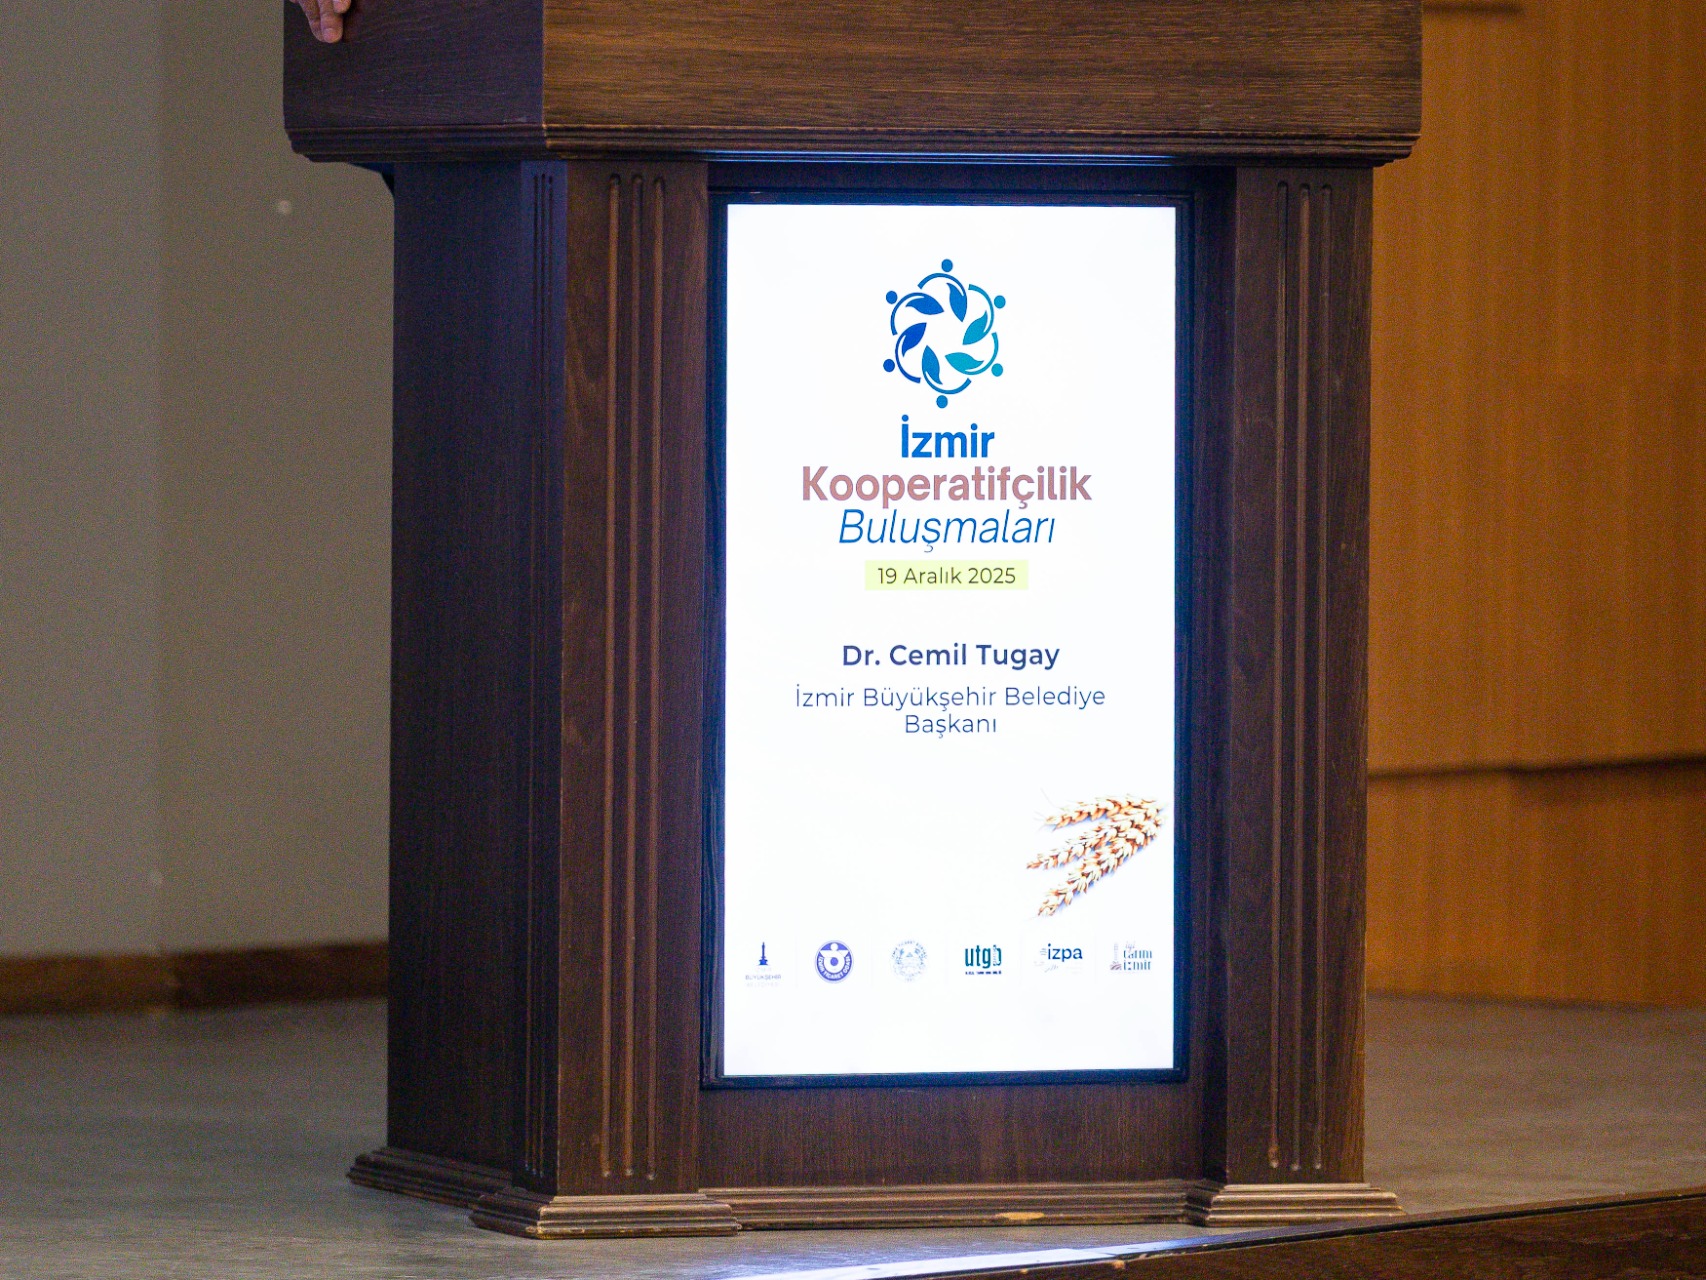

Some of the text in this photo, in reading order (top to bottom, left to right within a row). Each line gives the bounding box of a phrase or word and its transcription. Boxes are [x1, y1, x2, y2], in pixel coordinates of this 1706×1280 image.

[901, 414, 995, 458] İzmir
[803, 466, 1092, 509] Kooperatifçilik
[839, 509, 1056, 553] Buluşmaları
[878, 566, 1016, 584] 19 Aralık 2025
[843, 643, 1060, 670] Dr. Cemil Tugay
[796, 684, 1106, 711] İzmir Büyükşehir Belediye
[905, 714, 997, 739] Başkanı
[1047, 943, 1083, 962] izpa
